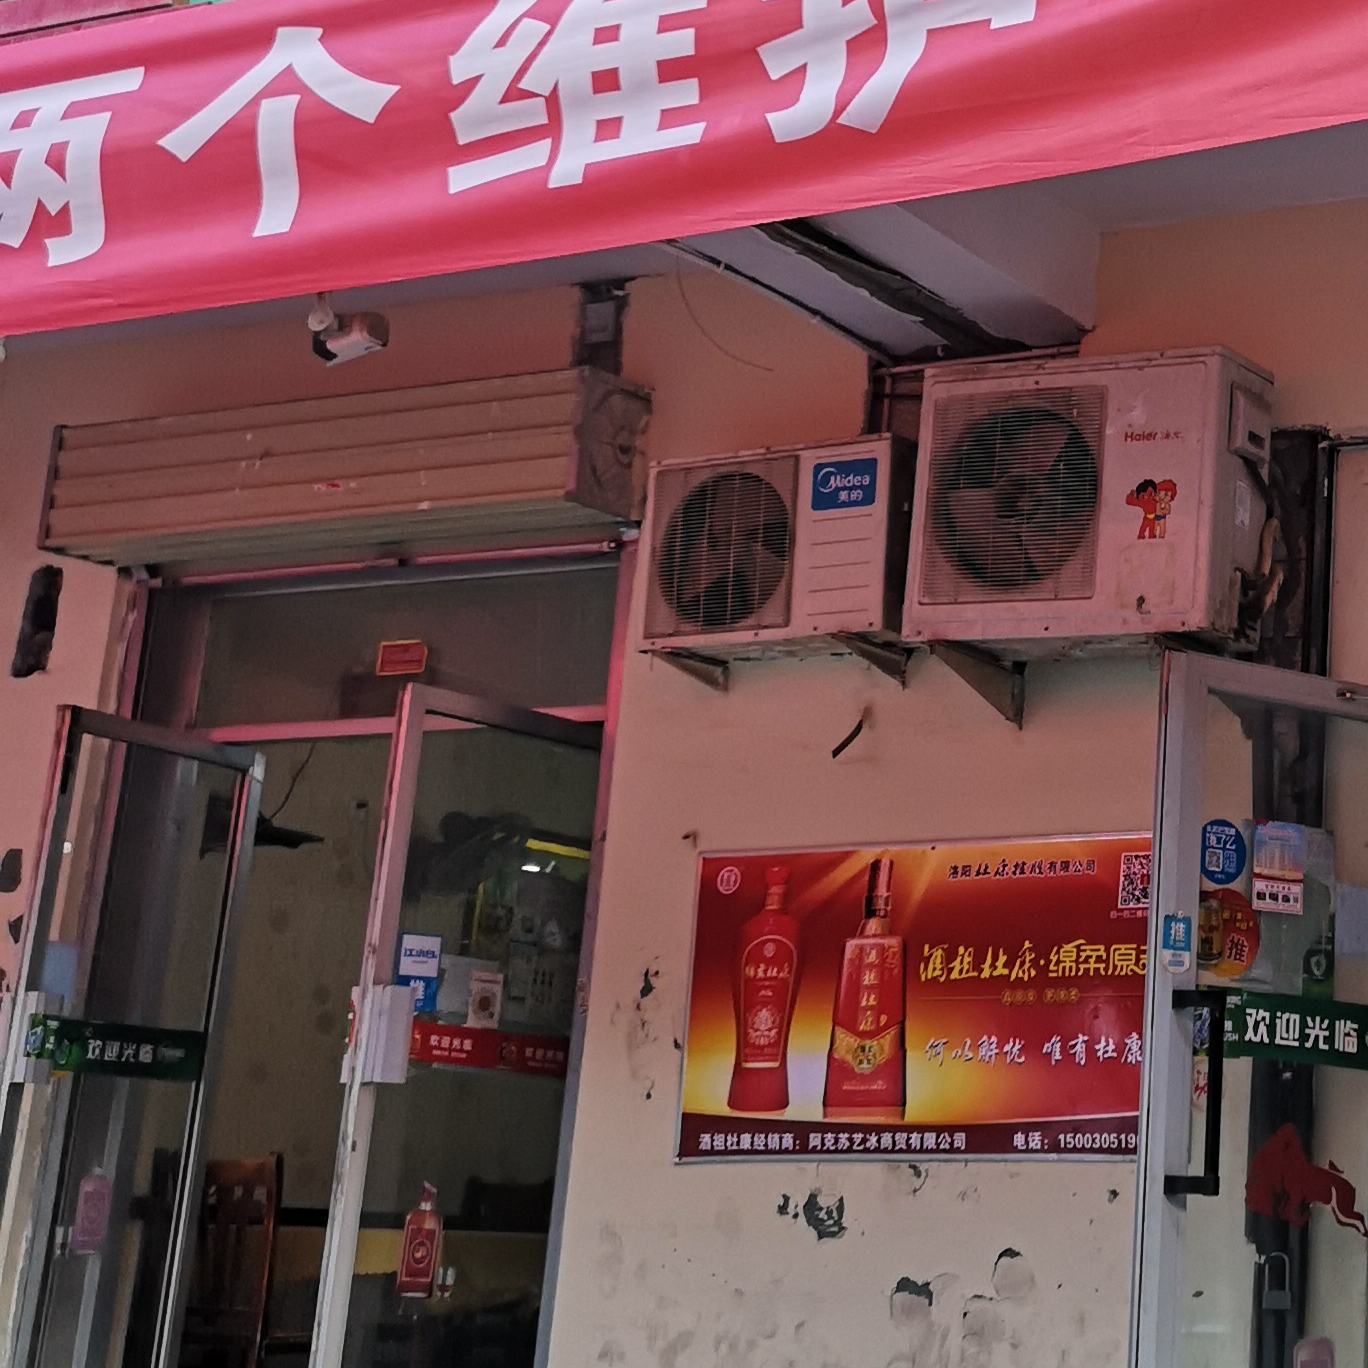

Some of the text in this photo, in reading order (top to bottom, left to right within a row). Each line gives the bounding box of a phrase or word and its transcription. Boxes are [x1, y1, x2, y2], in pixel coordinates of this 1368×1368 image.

[1125, 431, 1158, 443] Haier
[817, 467, 870, 492] Midea
[838, 489, 863, 503] 美的
[1170, 921, 1186, 941] 推
[1226, 935, 1249, 964] 推
[1244, 1008, 1359, 1054] 欢迎光临
[87, 1038, 154, 1064] 欢迎光临
[924, 1032, 1143, 1067] 何以解忧 唯有杜康
